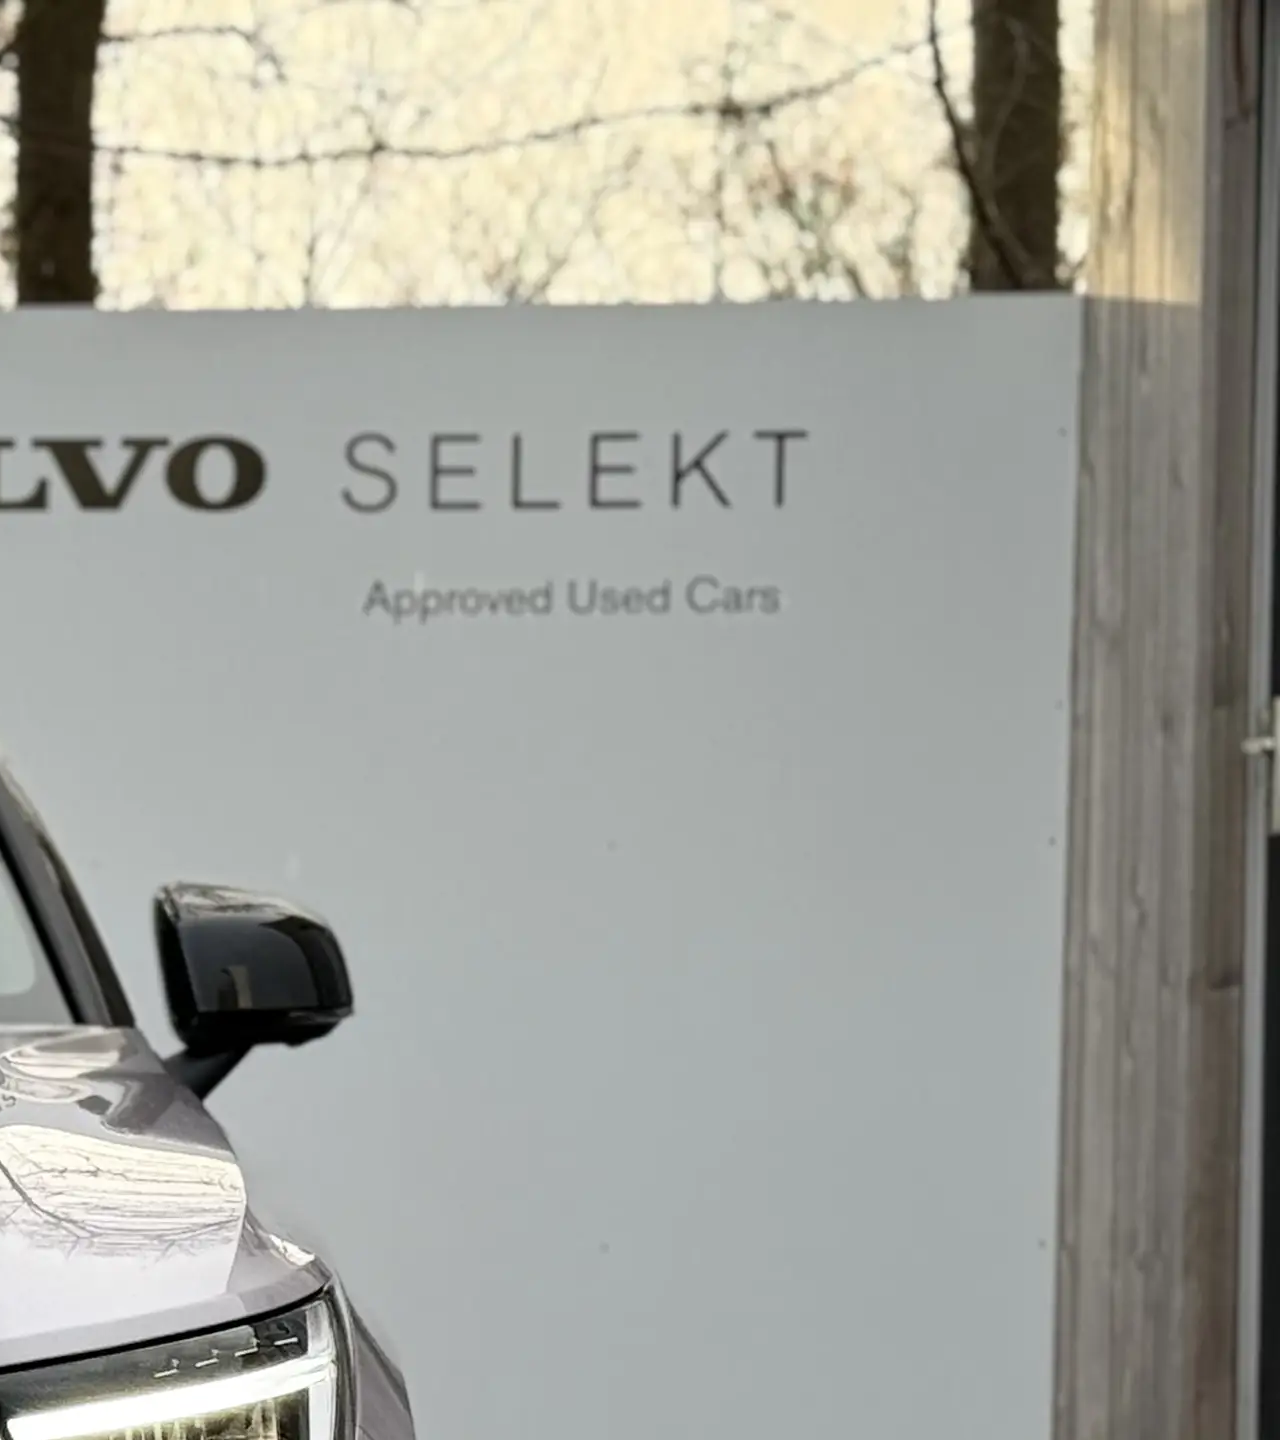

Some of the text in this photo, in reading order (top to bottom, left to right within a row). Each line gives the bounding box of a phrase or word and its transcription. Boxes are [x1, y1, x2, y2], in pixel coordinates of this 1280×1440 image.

[341, 429, 808, 515] SELEKT
[361, 573, 783, 626] Approved Used Cars
